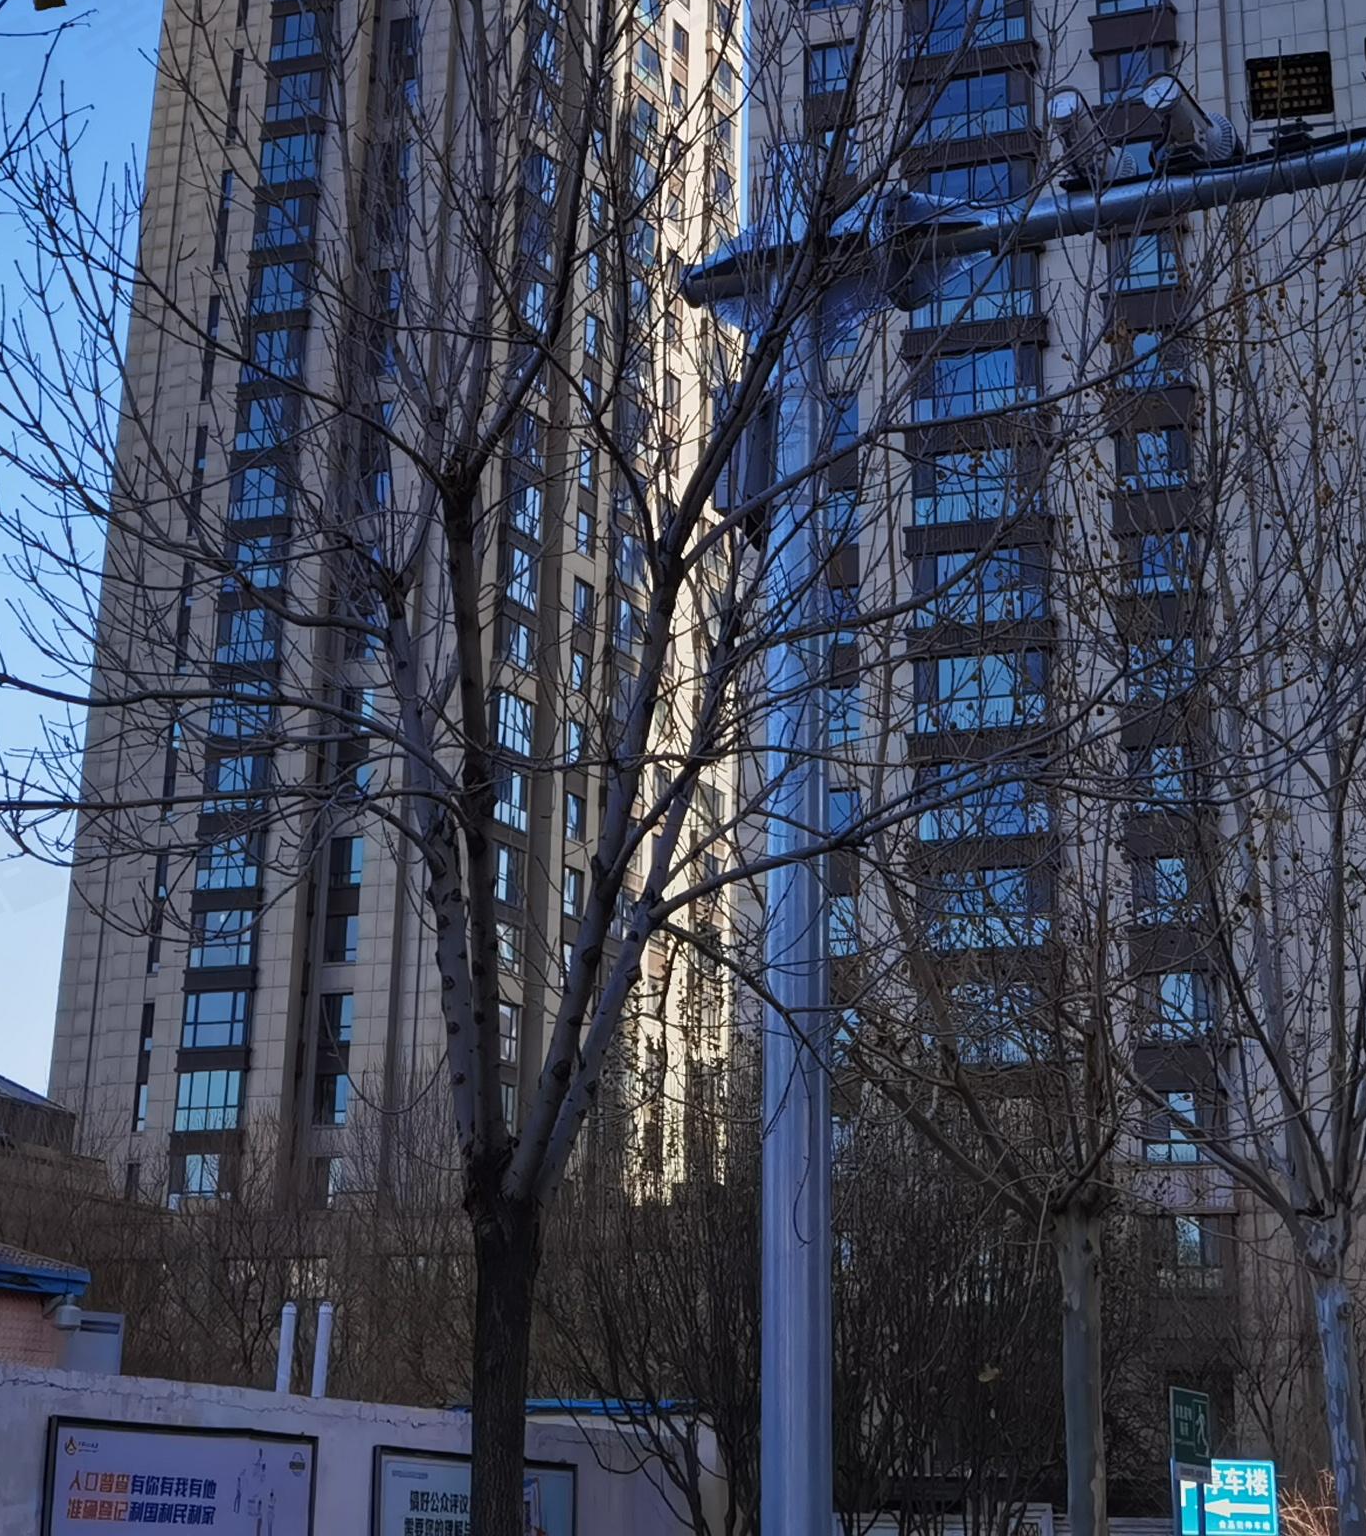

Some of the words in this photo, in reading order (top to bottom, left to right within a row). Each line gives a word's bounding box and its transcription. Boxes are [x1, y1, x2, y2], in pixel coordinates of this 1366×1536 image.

[68, 1470, 217, 1500] 人口普查有你有我有他
[1204, 1467, 1269, 1496] 停车楼
[67, 1498, 216, 1525] 准确登记利国利民利家
